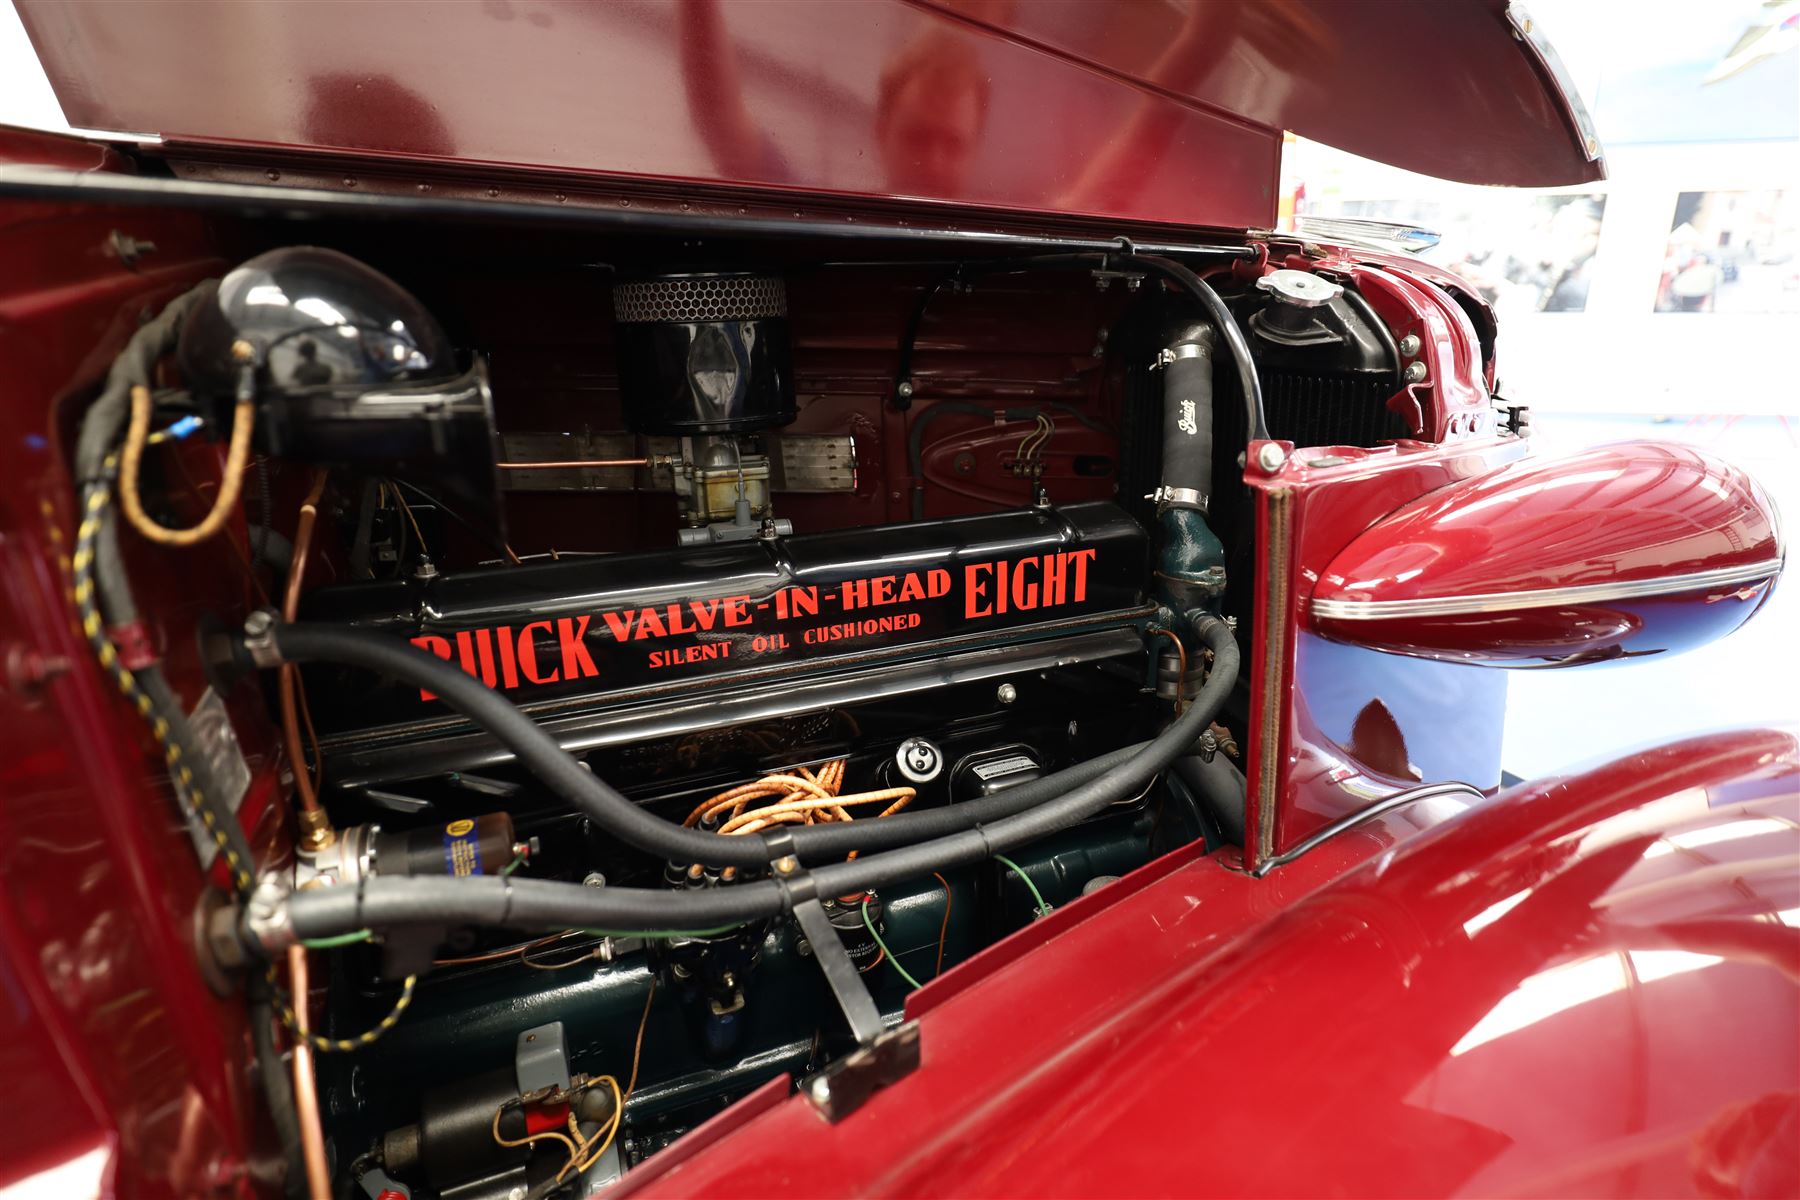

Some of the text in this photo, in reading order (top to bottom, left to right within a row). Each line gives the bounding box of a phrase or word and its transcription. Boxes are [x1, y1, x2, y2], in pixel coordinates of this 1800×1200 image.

[1177, 399, 1198, 435] Buick
[602, 568, 952, 643] VALVE-IN-HEAD
[964, 548, 1097, 619] EIGHT
[648, 613, 921, 669] SILENT OIL CUSHIONED
